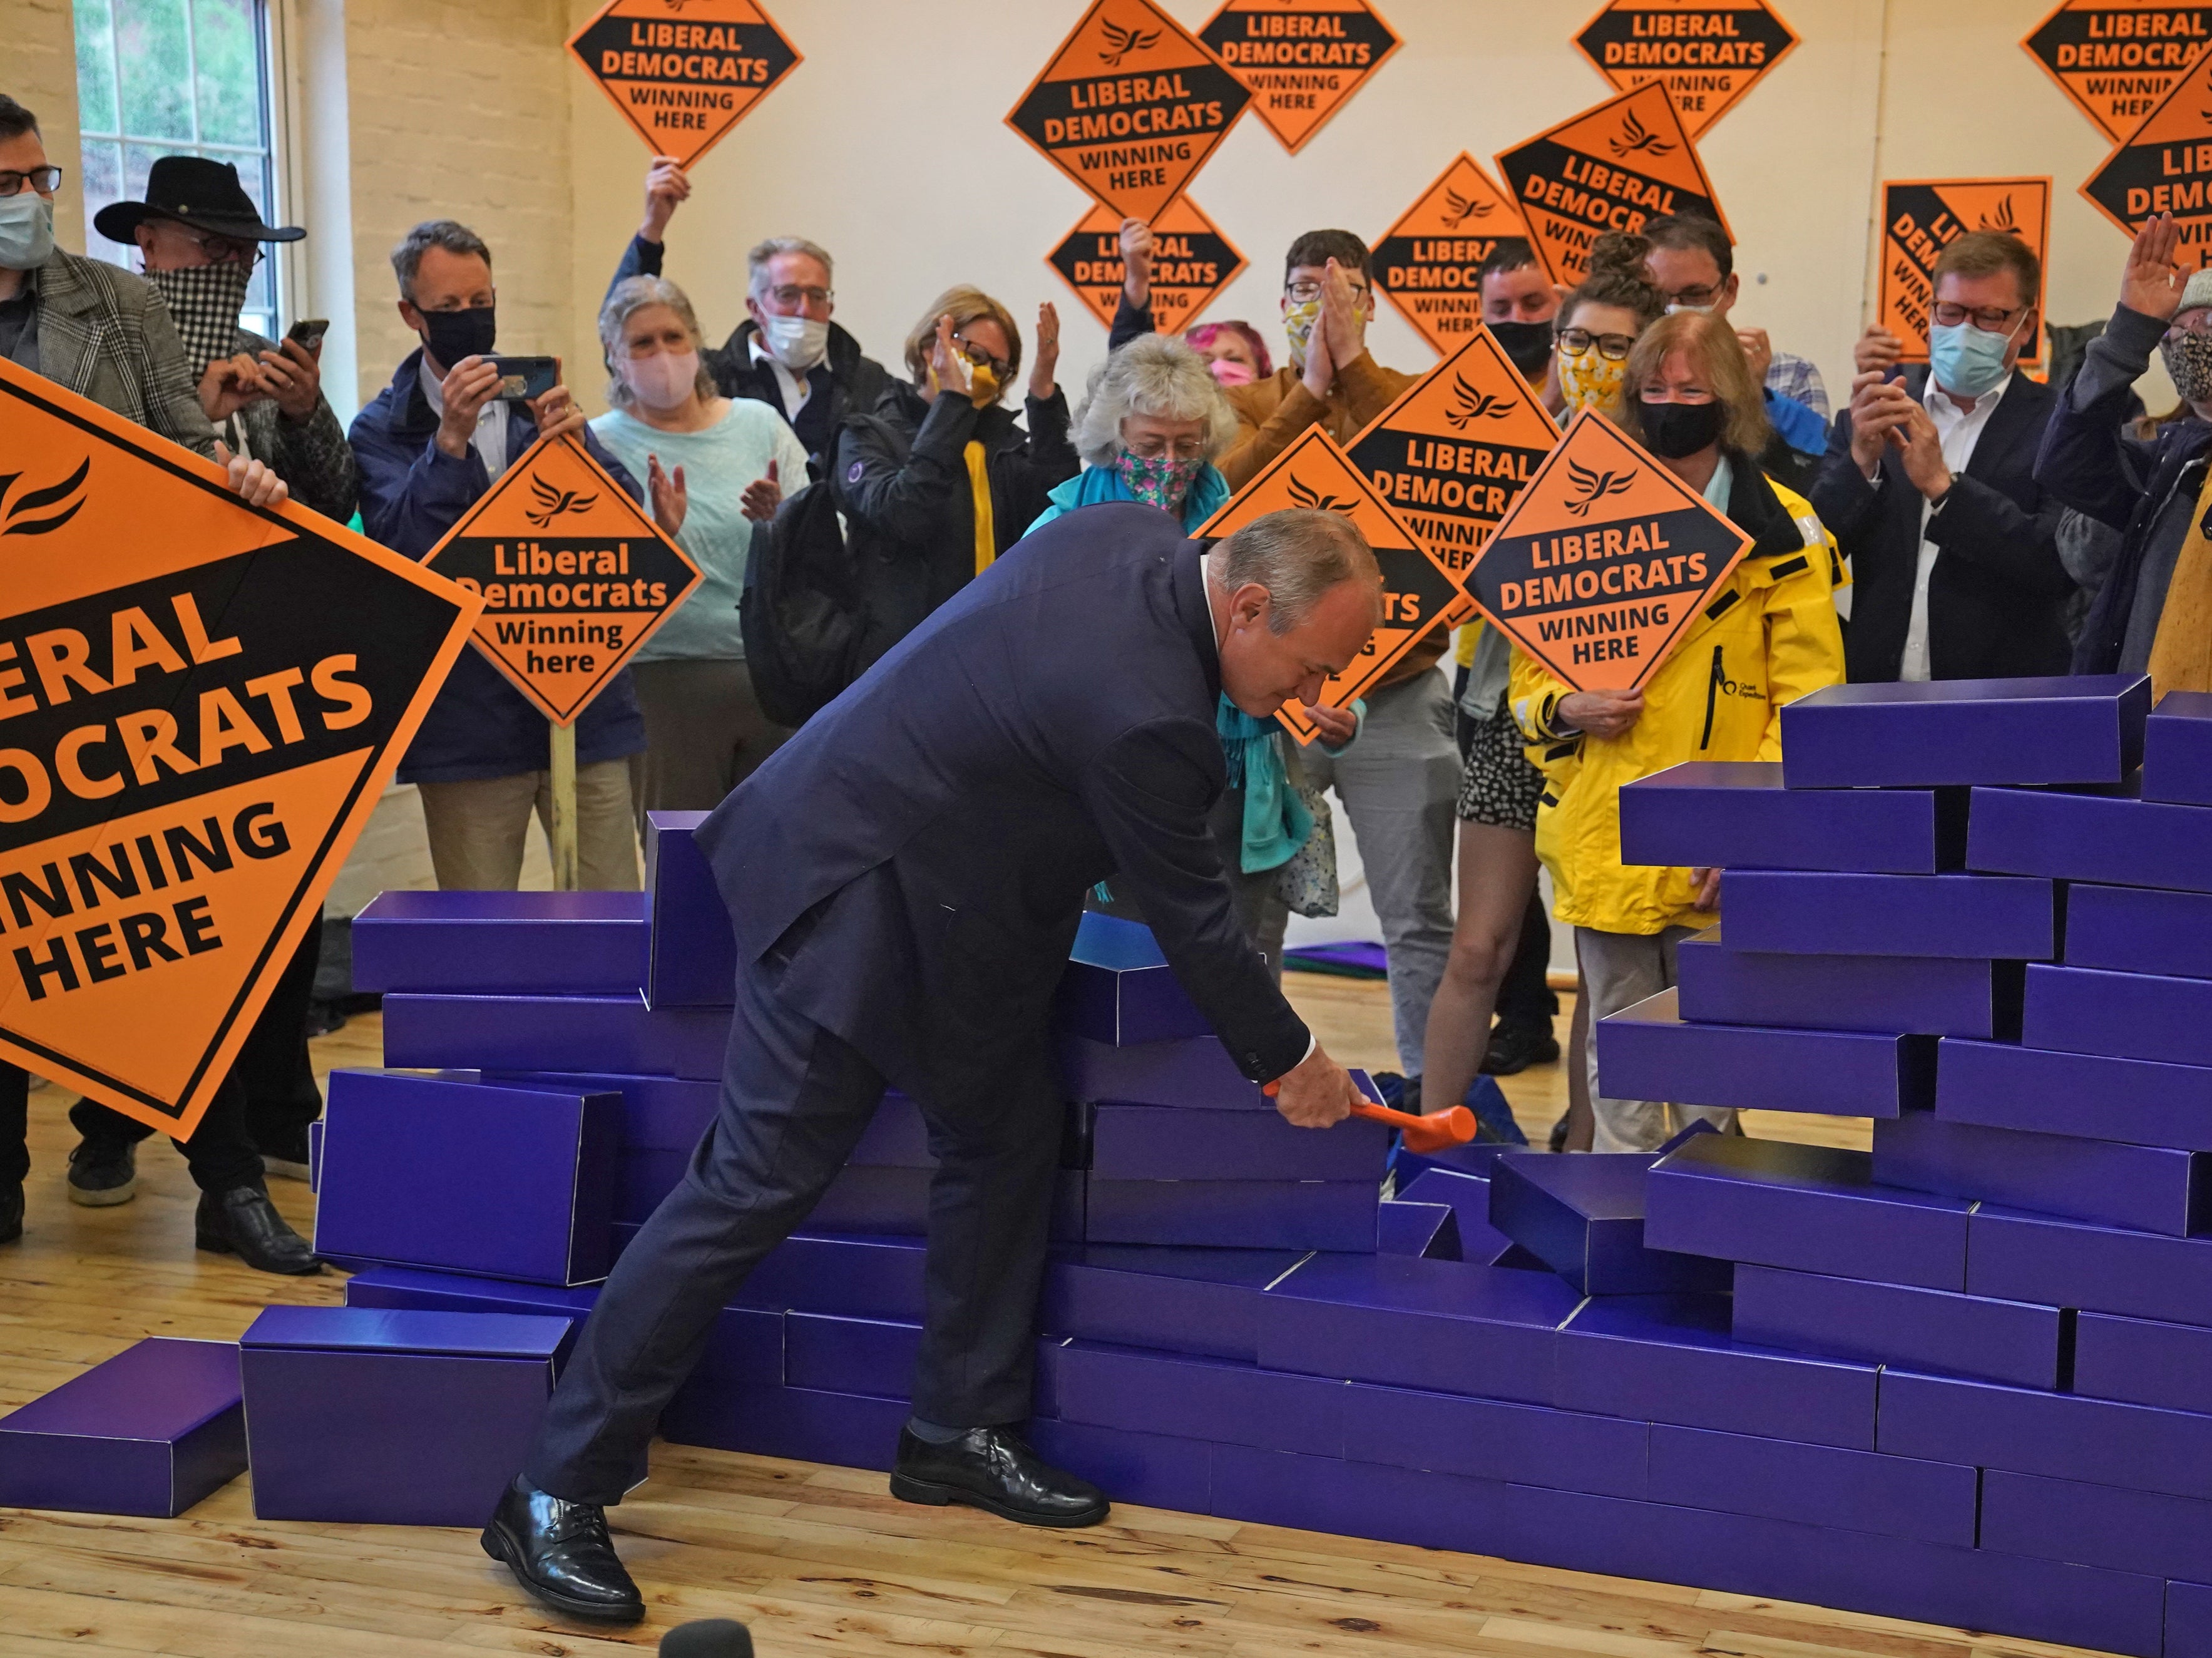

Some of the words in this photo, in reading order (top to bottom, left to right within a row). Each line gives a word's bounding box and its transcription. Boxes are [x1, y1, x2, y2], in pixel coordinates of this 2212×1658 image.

[631, 23, 742, 51] LIBERAL
[1247, 15, 1346, 38] LIBERAL
[1632, 14, 1739, 37] LIBERAL
[2089, 13, 2207, 38] LIBERAL
[602, 49, 768, 82] DEMOCRATS
[1222, 41, 1371, 64] DEMOCRATS
[1605, 41, 1765, 64] DEMOCRATS
[630, 88, 733, 110] WINNING
[1071, 74, 1190, 109] LIBERAL
[1270, 95, 1316, 109] HERE
[654, 111, 706, 130] HERE
[1044, 101, 1223, 143] DEMOCRATS
[1079, 142, 1190, 170] WINNING
[1110, 168, 1165, 189] HERE
[1562, 155, 1675, 216] LIBERAL
[1523, 174, 1647, 235] DEMOCR
[1098, 236, 1193, 258] LIRAL
[1074, 262, 1217, 283] DEMCRATS
[1388, 267, 1478, 288] DEMOC
[1415, 299, 1478, 313] WINNI
[1406, 439, 1534, 482] LIBERAL
[494, 542, 628, 575] Liberal
[1532, 521, 1669, 569] LIBERAL
[1500, 552, 1708, 611] DEMOCRATS
[496, 619, 623, 649] Winning
[1538, 604, 1669, 642] WINNING
[0, 591, 243, 720] ERAL
[527, 650, 595, 673] here
[1573, 635, 1639, 665] HERE
[0, 654, 372, 823] OCRATS
[0, 802, 291, 934] NNING
[13, 895, 223, 1001] HERE
